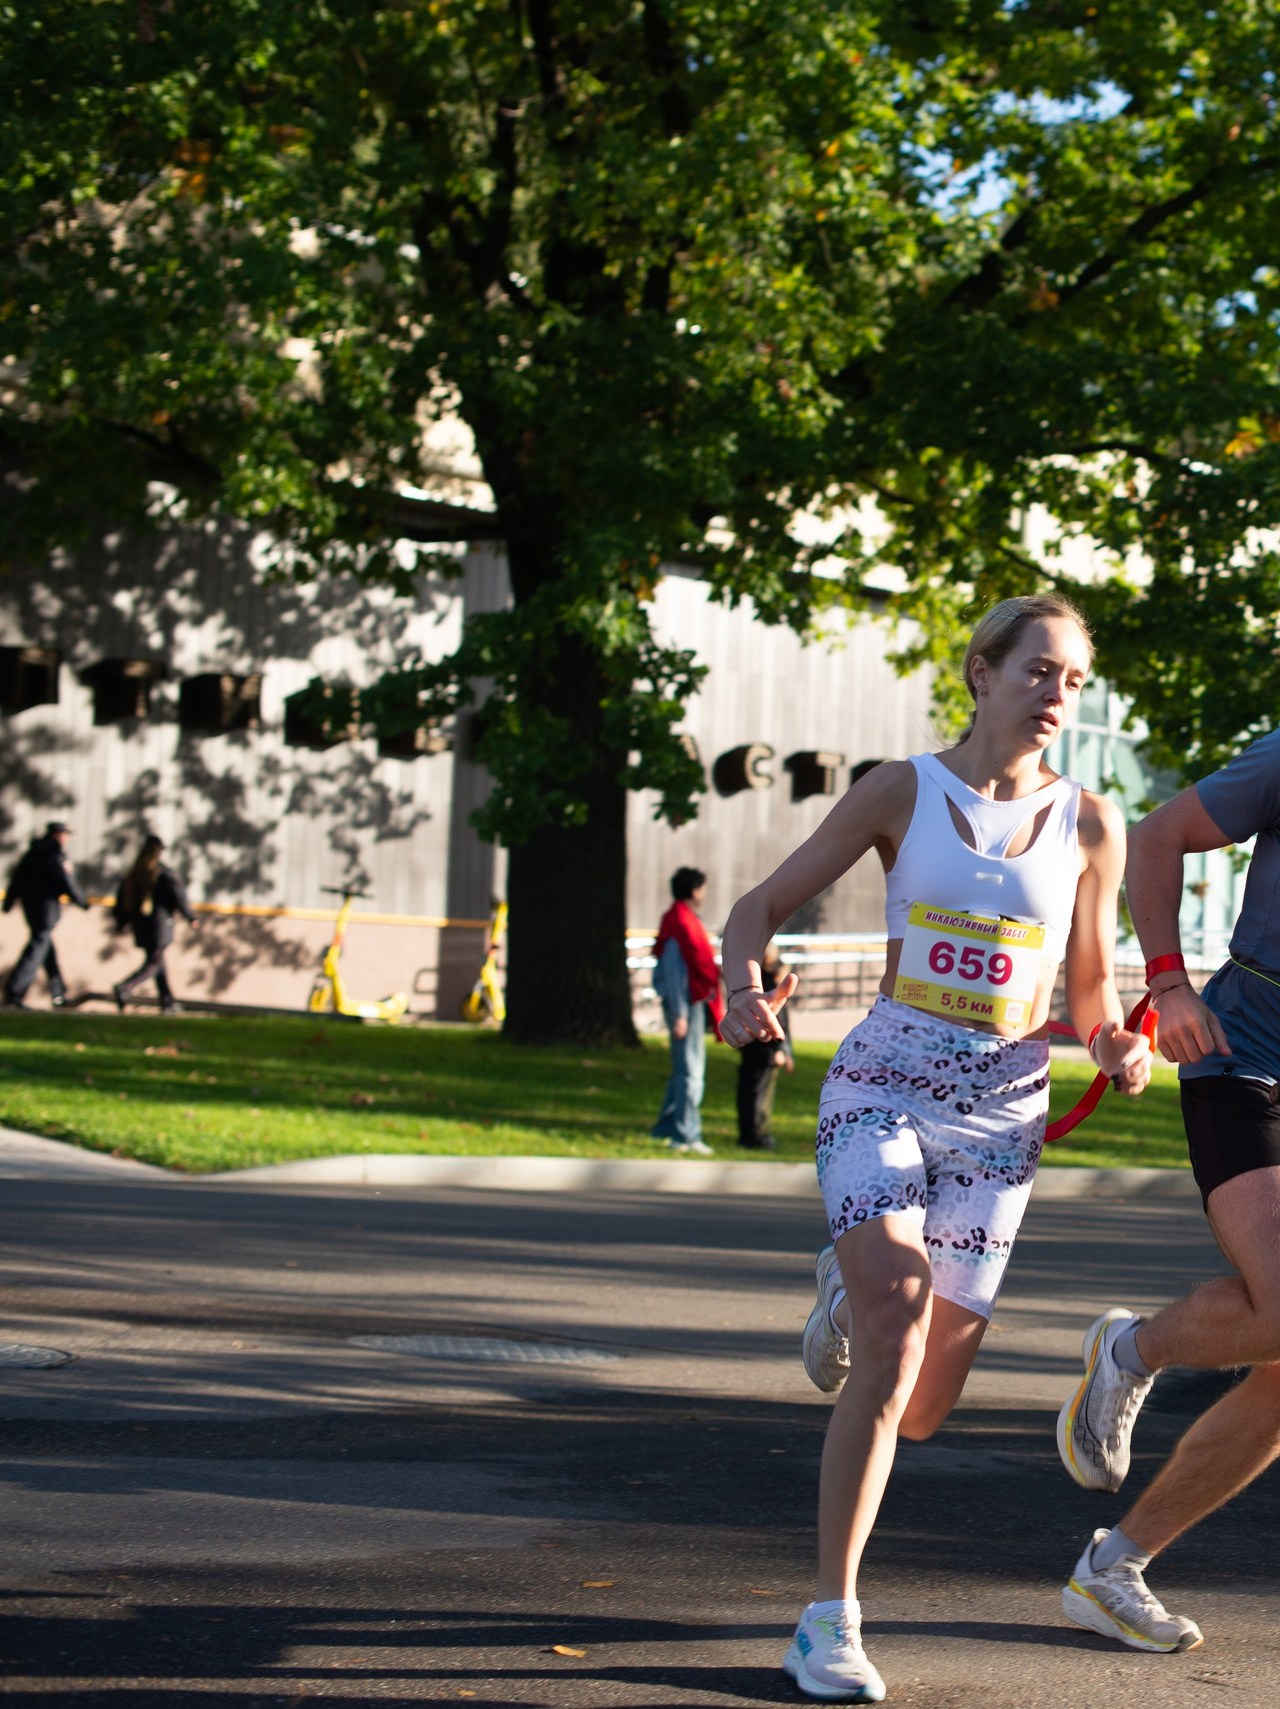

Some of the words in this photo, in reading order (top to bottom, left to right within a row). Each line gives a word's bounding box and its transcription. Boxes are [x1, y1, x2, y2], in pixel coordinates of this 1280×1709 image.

[925, 911, 999, 935] ИНКЛЮЗИВНЫЙ
[1000, 927, 1028, 941] ЗАБЕГ
[928, 941, 1013, 986] 659
[940, 992, 968, 1011] 5,5
